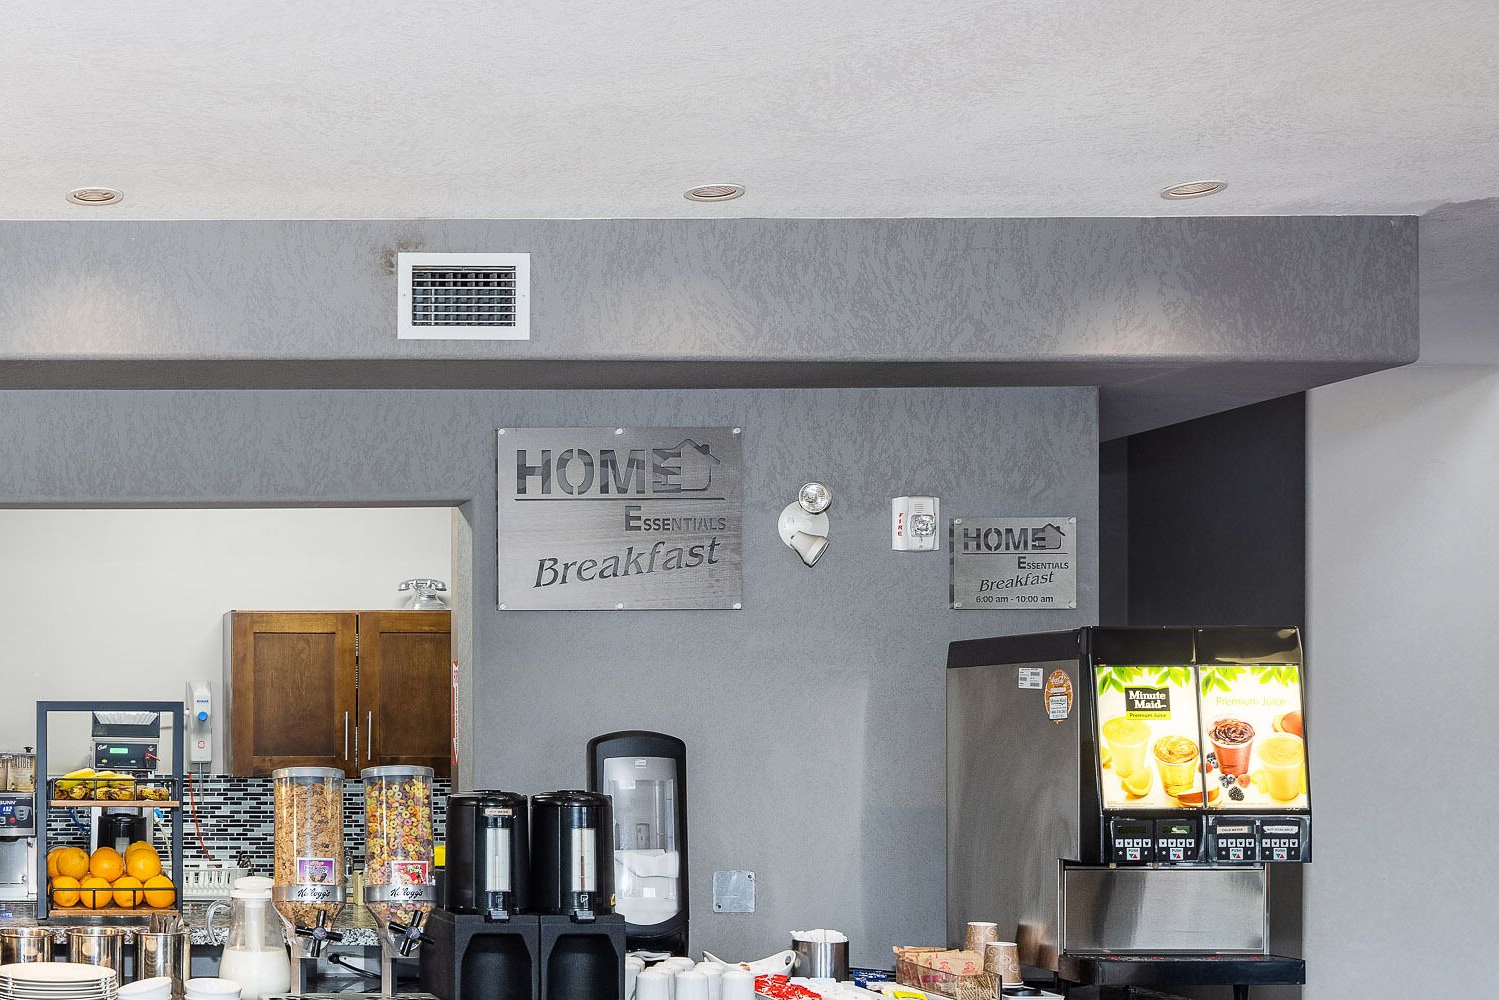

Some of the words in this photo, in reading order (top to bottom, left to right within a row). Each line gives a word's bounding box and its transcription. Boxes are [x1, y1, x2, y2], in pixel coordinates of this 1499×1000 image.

[516, 448, 682, 495] HOME
[963, 527, 1046, 552] HOME
[533, 536, 722, 588] Breakfast
[979, 571, 1055, 592] Breakfast
[975, 595, 994, 603] 6:00
[1016, 595, 1039, 603] 10:00
[1128, 690, 1166, 700] Minute
[1215, 696, 1260, 706] Premium
[1262, 696, 1286, 706] Juice
[1134, 699, 1162, 709] Maid
[297, 887, 331, 900] Kelogg's
